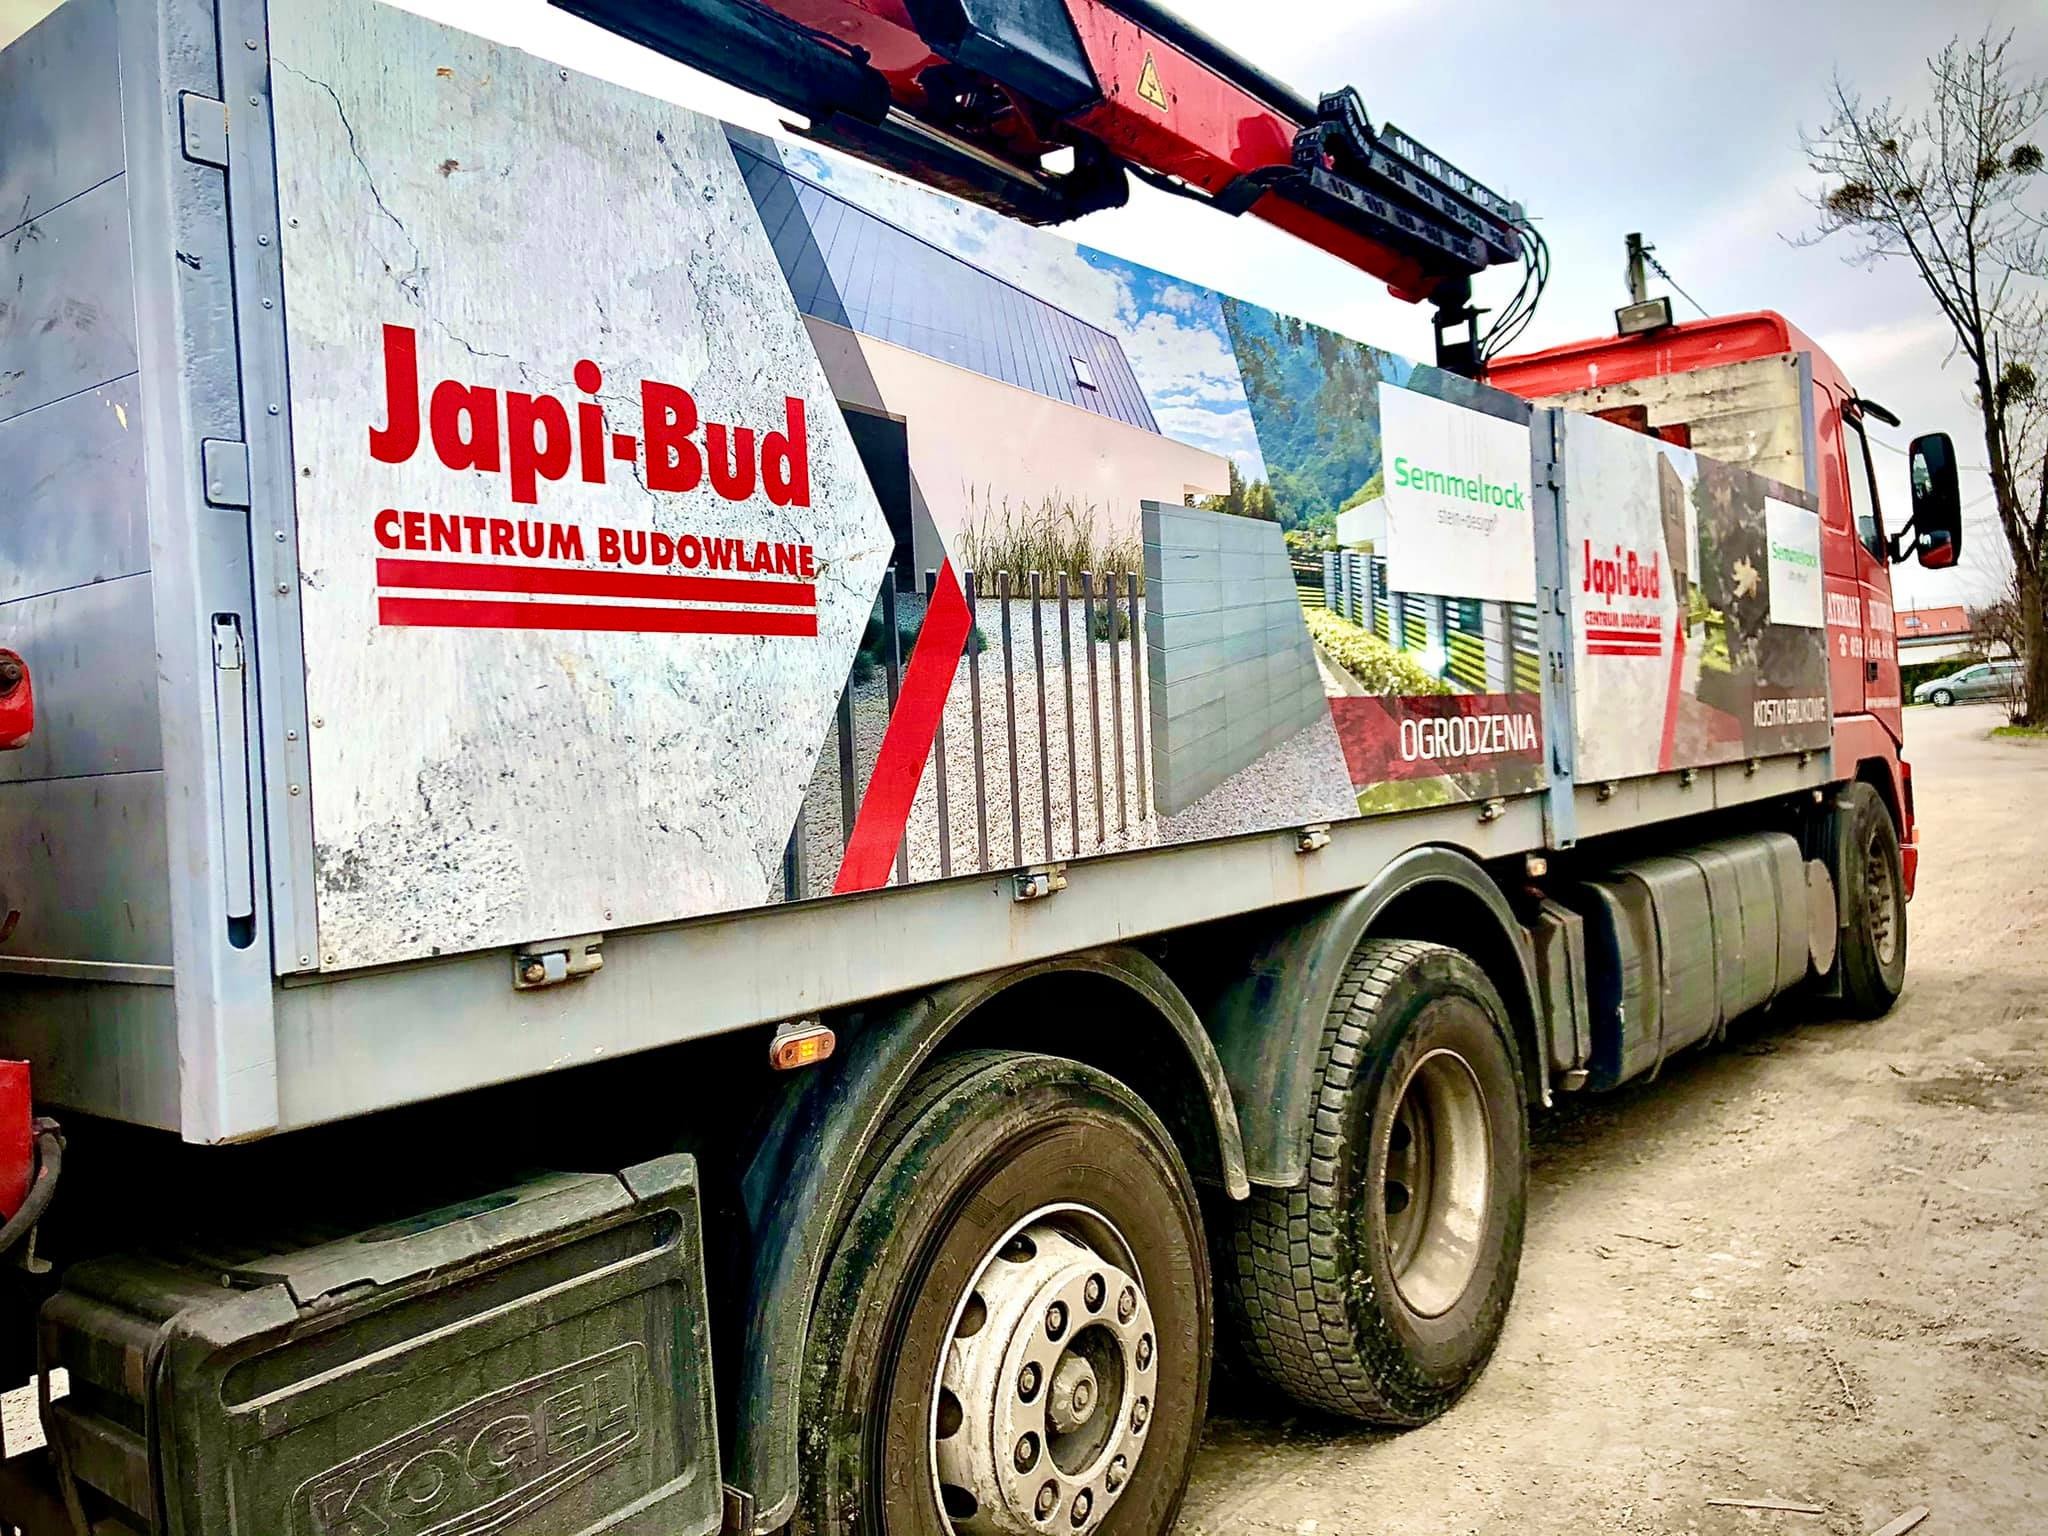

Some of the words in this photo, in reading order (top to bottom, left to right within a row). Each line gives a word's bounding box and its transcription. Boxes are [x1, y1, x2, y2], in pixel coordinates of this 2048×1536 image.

[369, 323, 811, 508] Japi-Bud
[1394, 456, 1525, 511] Semmelrock
[374, 508, 585, 561] CENTRUM
[600, 527, 815, 577] BUDOWLANE
[1583, 539, 1660, 605] Japi-Bud
[1400, 713, 1538, 762] OGRODZENIA
